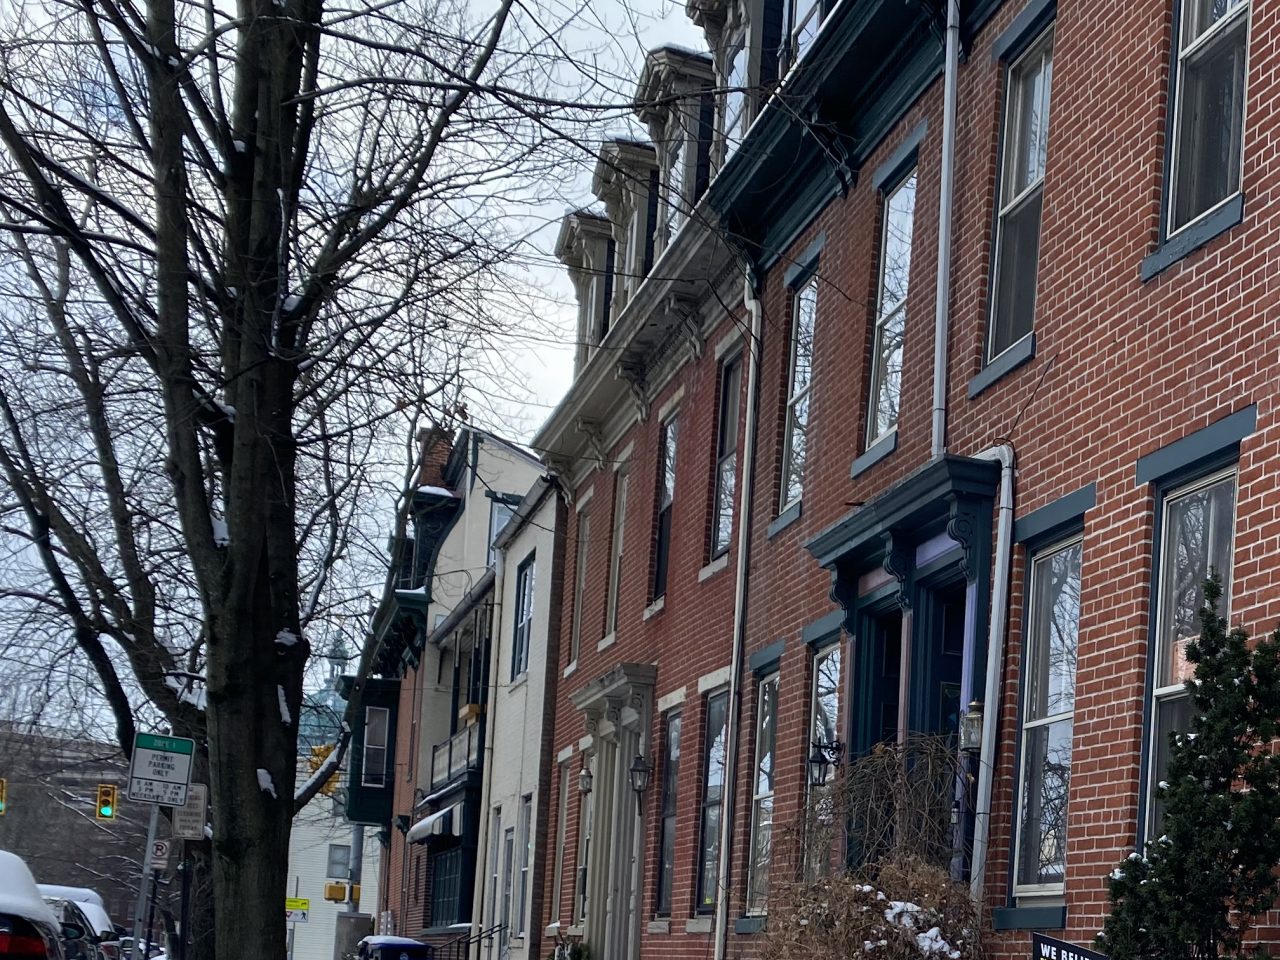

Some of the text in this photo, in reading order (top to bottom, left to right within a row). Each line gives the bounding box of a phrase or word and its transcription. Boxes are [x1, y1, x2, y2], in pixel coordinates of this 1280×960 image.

[151, 753, 175, 762] PERMIT
[148, 760, 175, 770] PARKING
[152, 768, 170, 777] ONLY
[131, 791, 183, 804] WEEKDAYS ONLY
[1040, 942, 1057, 960] WE
